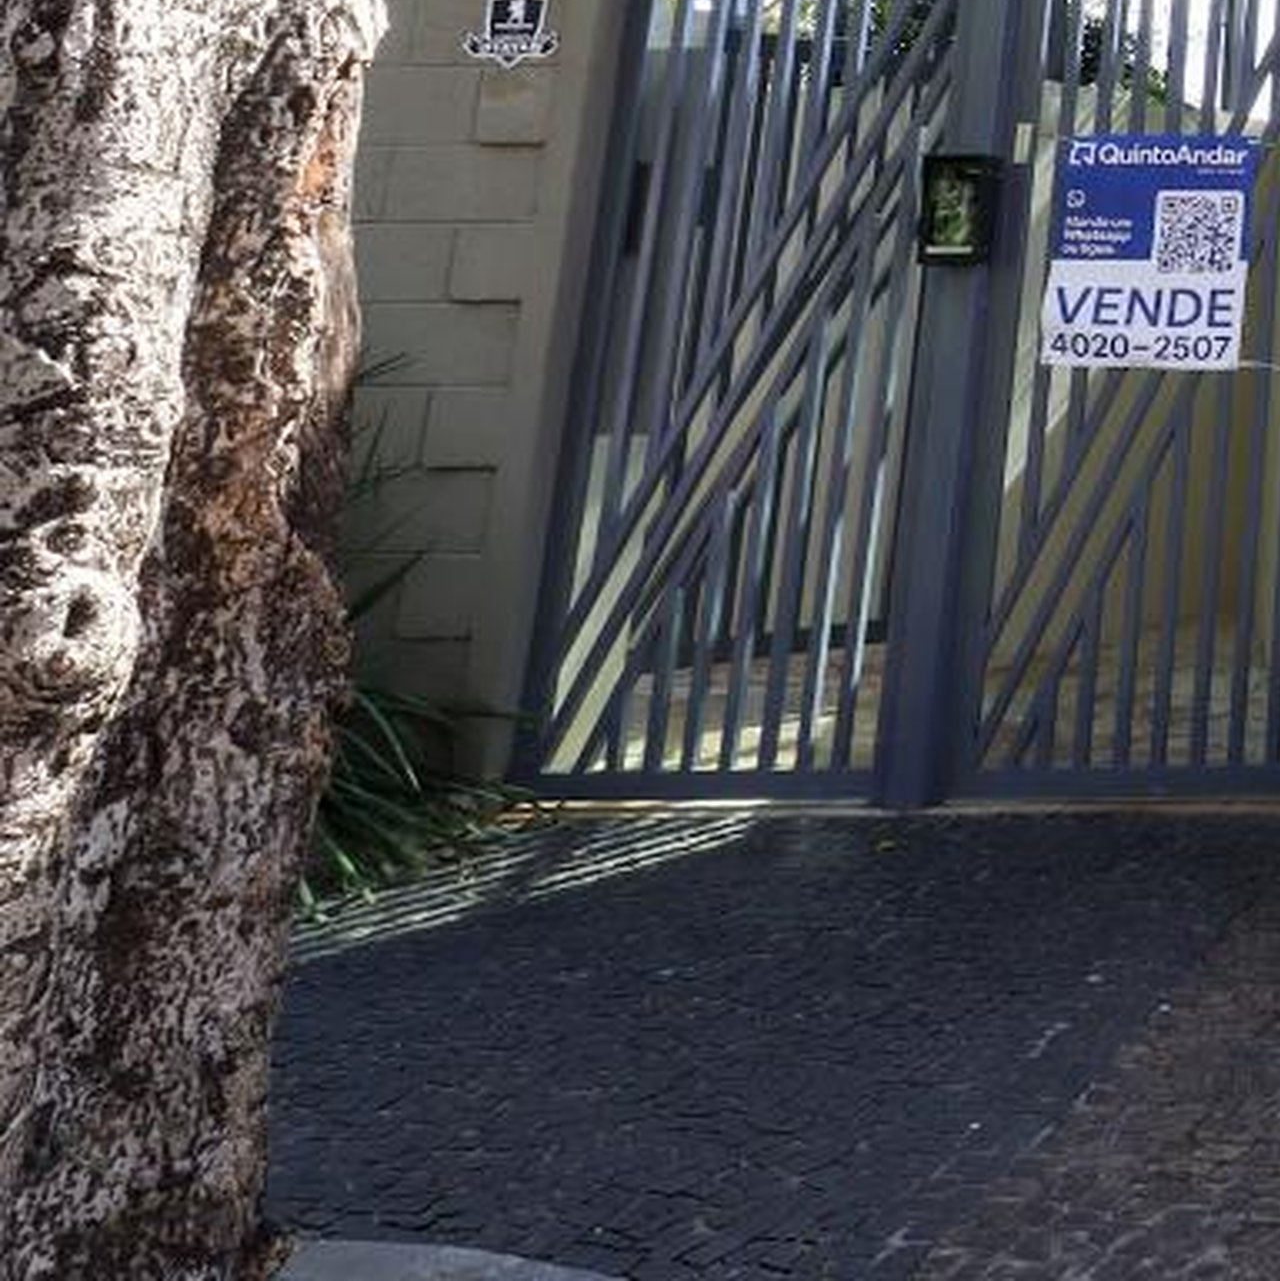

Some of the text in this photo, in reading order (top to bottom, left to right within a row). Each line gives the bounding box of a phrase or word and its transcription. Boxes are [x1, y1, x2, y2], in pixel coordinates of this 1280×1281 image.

[1099, 142, 1249, 166] QuintoAndar
[1057, 287, 1235, 328] VENDE
[1051, 333, 1232, 360] 4020-2507
